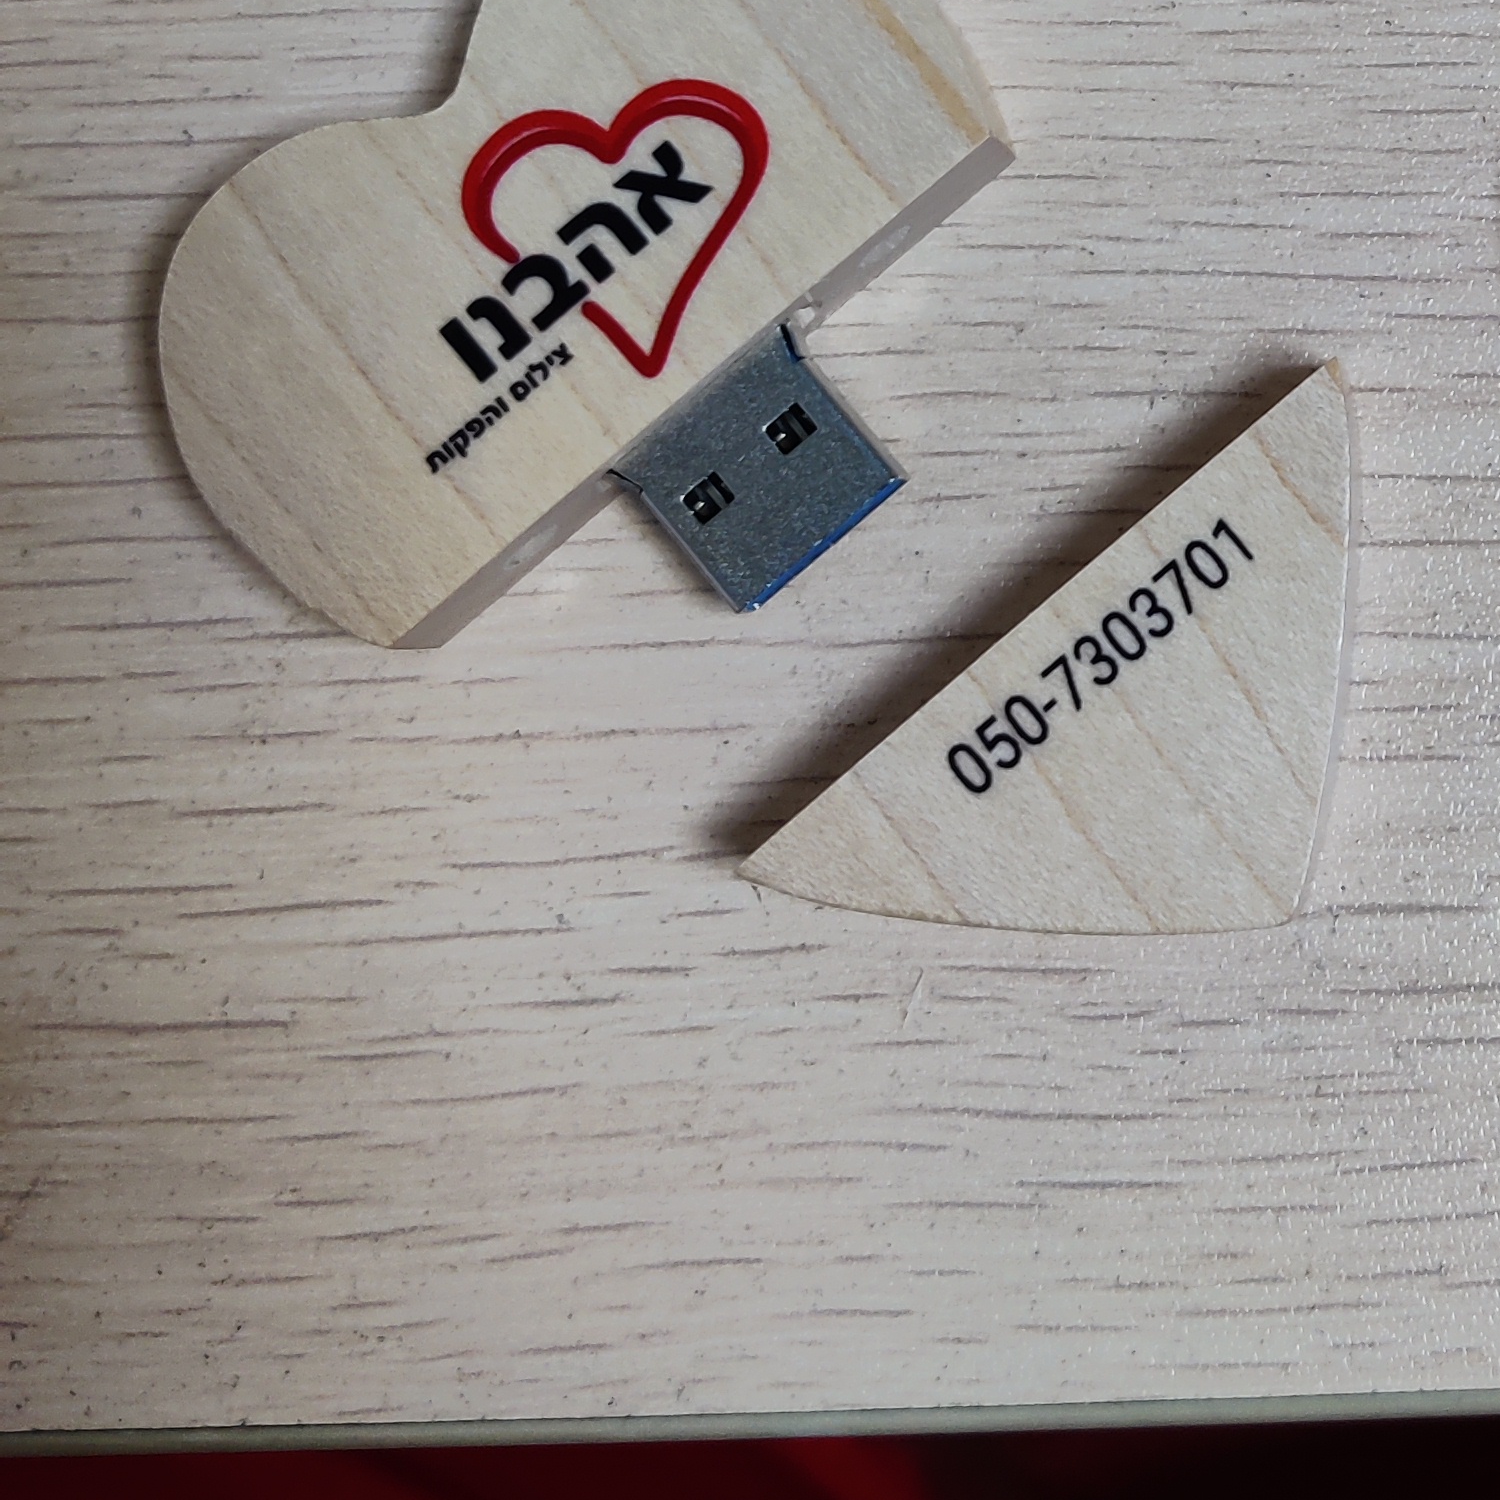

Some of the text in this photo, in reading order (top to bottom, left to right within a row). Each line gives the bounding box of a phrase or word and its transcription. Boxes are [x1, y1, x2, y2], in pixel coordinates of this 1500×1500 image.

[439, 140, 715, 383] אהבנו
[425, 342, 574, 474] צילום והפקות
[946, 517, 1254, 794] 050-7303701
